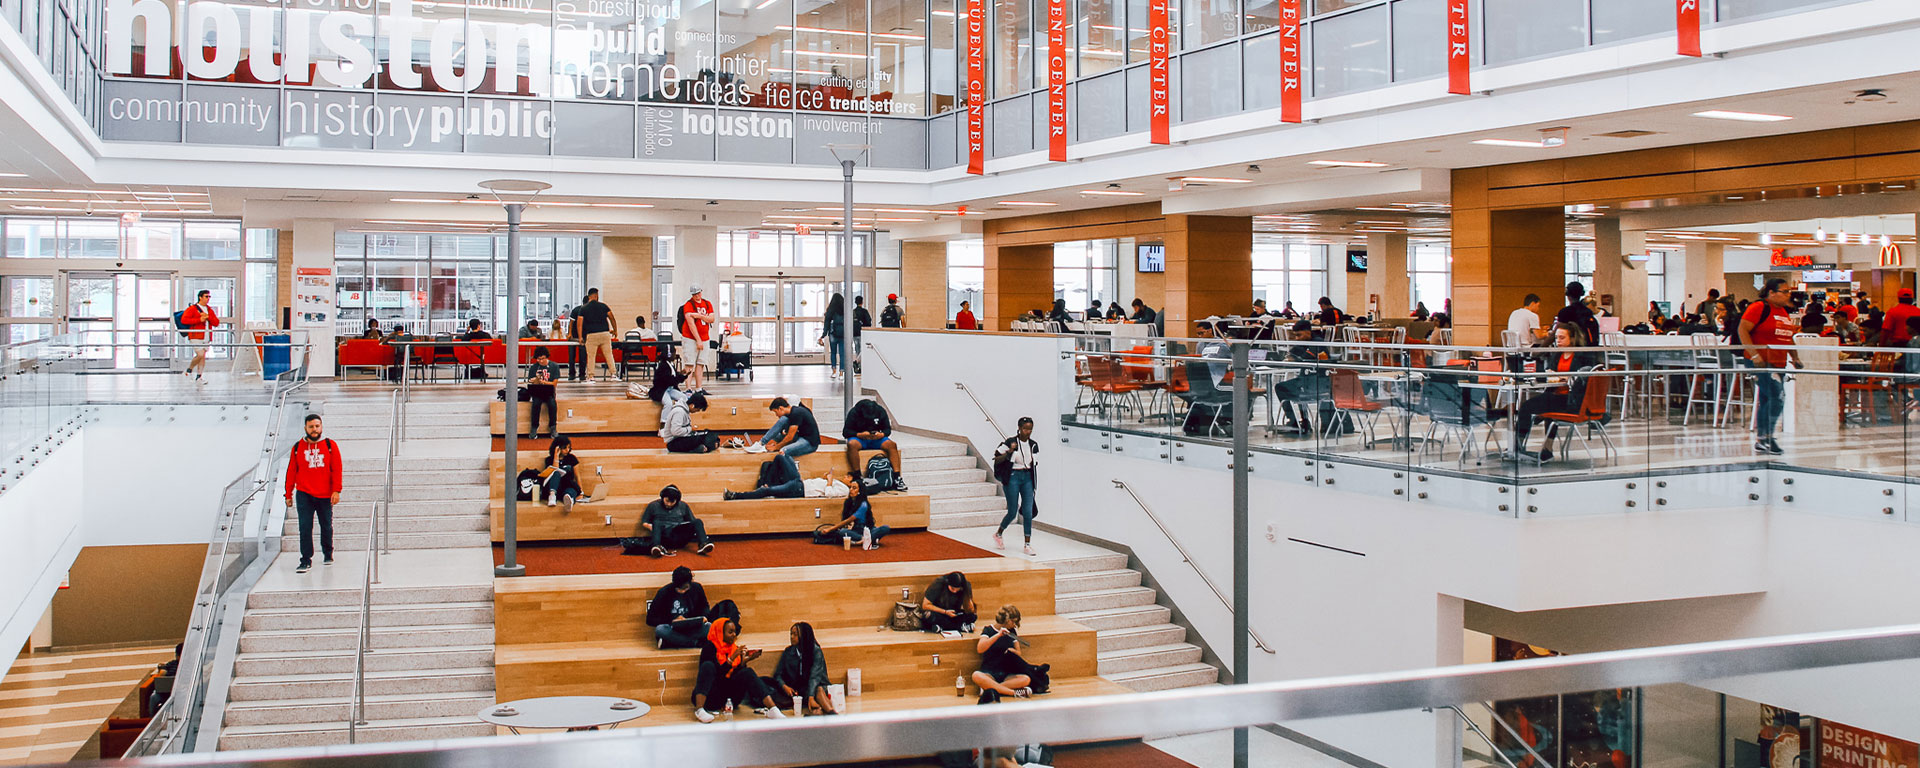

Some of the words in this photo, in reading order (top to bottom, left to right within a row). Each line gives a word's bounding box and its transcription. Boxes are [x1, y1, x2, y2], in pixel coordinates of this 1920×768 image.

[588, 0, 681, 21] prestigious
[105, 0, 556, 97] houston
[587, 22, 666, 56] build
[1451, 3, 1466, 60] TER
[696, 50, 768, 77] frontier
[874, 71, 892, 84] city
[1153, 26, 1166, 118] CENTER
[686, 74, 751, 106] ideas
[764, 82, 824, 110] fierce
[820, 76, 853, 91] cutting
[855, 77, 880, 91] edge
[1051, 56, 1064, 138] CENTER
[109, 97, 272, 132] community
[286, 91, 425, 148] history
[430, 100, 558, 143] public
[829, 96, 917, 114] trendsetters
[970, 80, 982, 153] CENTER
[643, 106, 657, 156] opportunity
[655, 109, 674, 147] civic
[682, 108, 793, 139] houston
[803, 115, 883, 135] involvement
[1821, 725, 1888, 756] DESIGN
